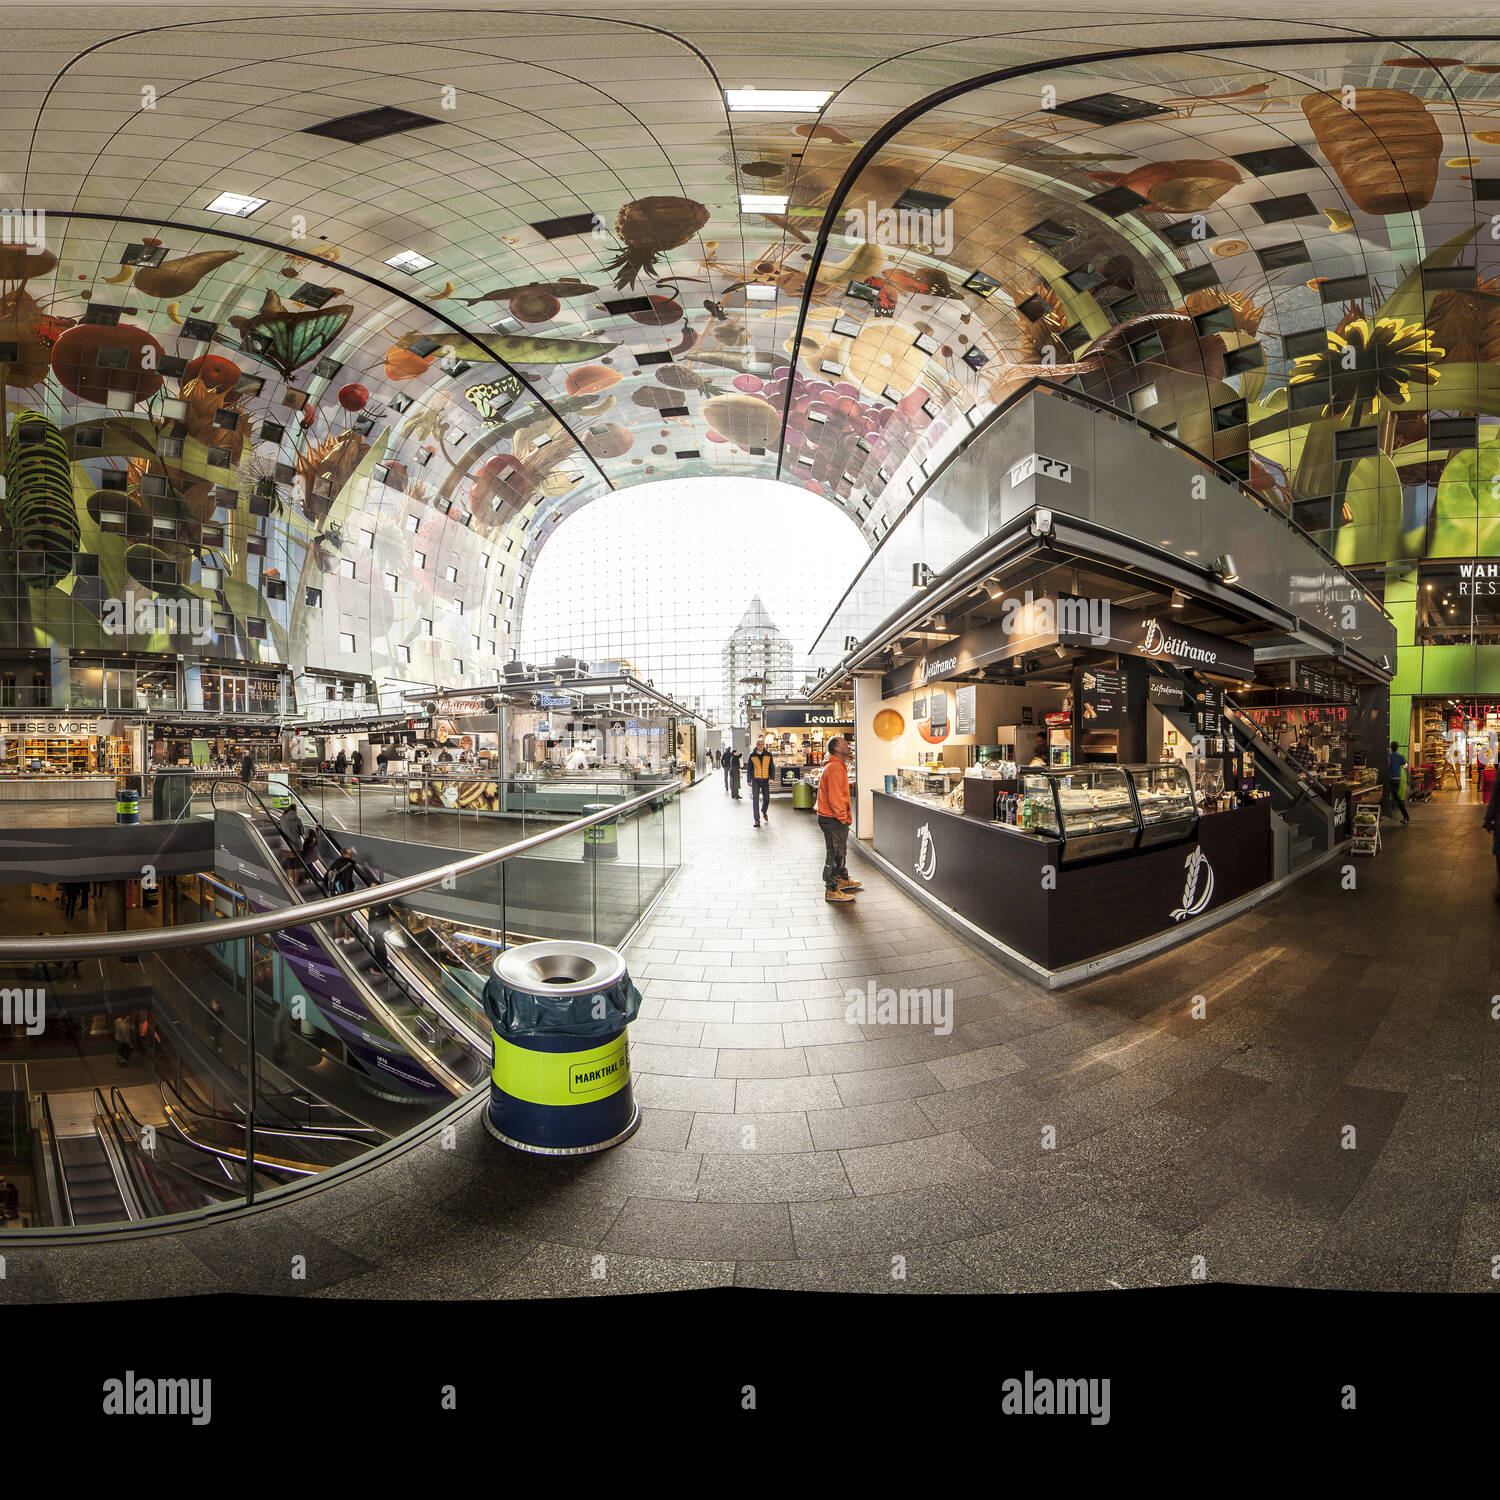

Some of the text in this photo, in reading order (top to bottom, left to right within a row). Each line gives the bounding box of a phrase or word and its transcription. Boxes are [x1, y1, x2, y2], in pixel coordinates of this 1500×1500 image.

[1038, 456, 1068, 477] 77
[1460, 564, 1498, 578] WAH
[1137, 618, 1217, 664] Délifrance
[48, 723, 56, 733] &
[58, 723, 97, 733] MORE
[575, 1056, 625, 1084] MARKTHAL IS
